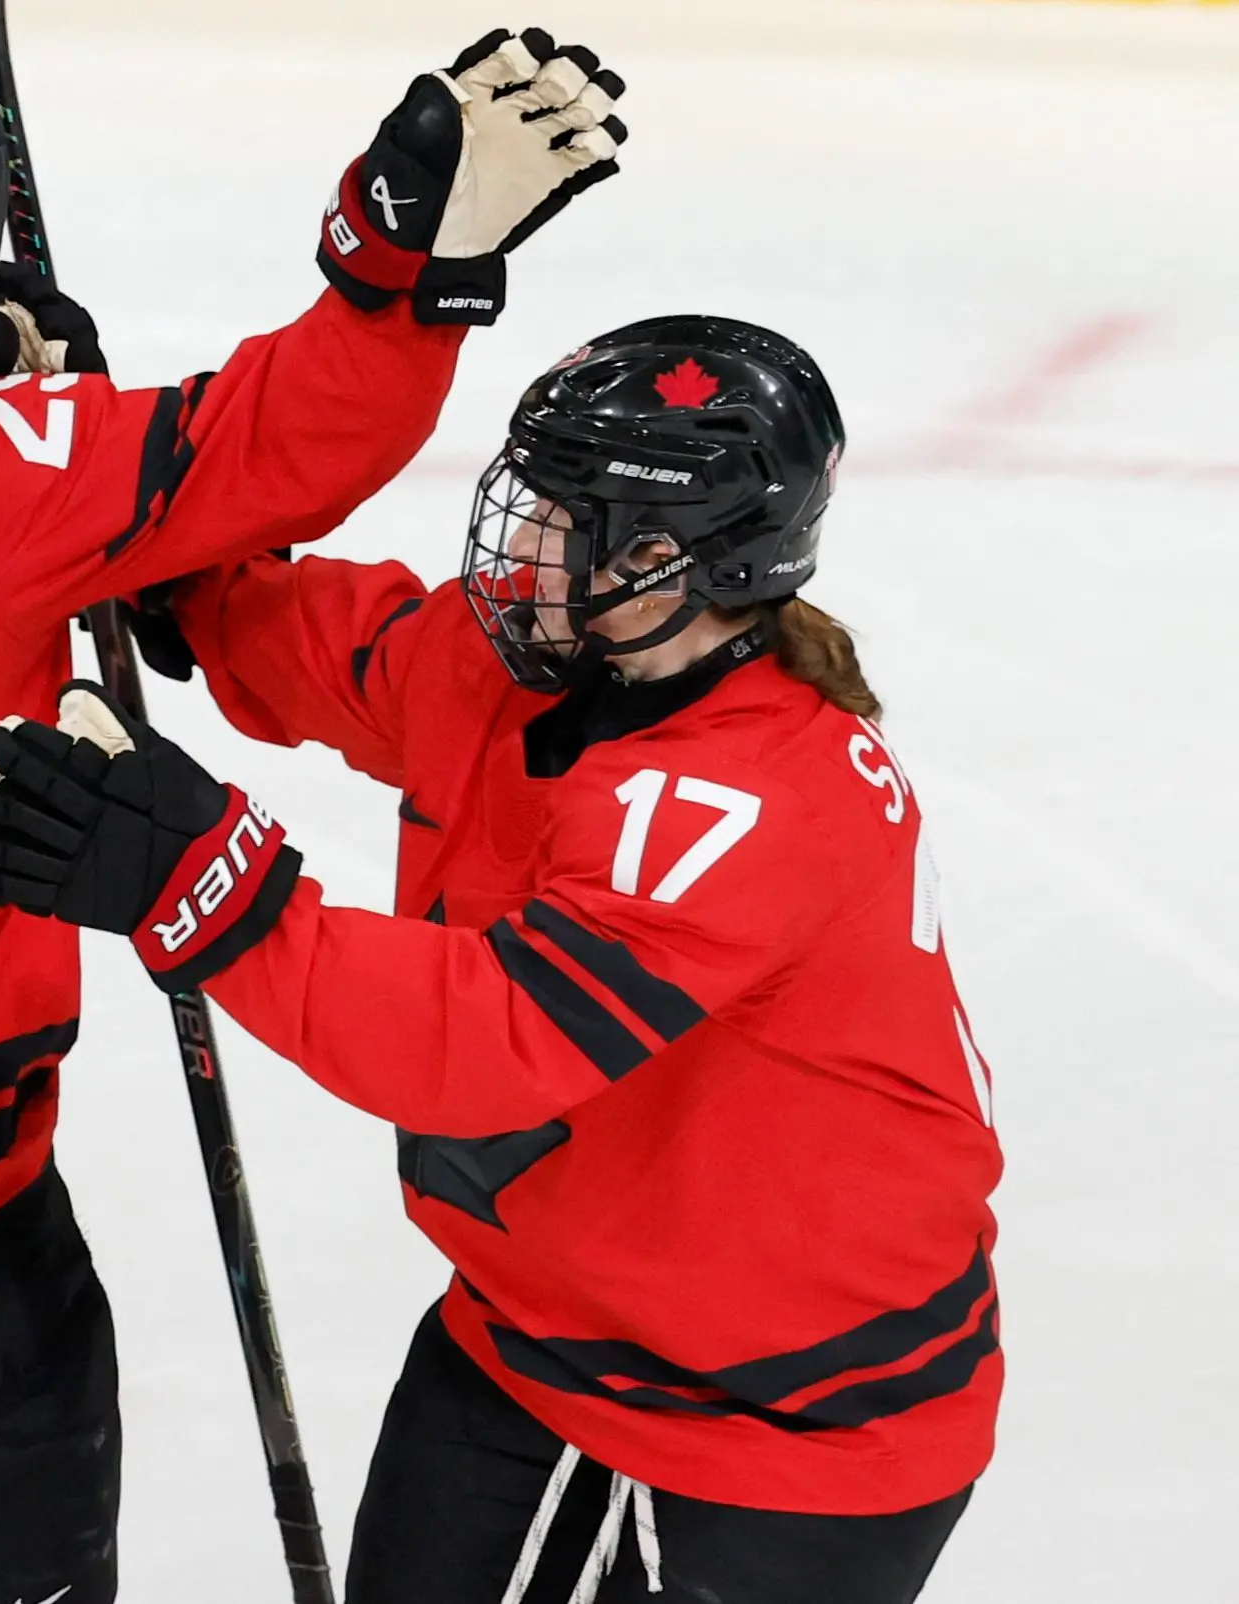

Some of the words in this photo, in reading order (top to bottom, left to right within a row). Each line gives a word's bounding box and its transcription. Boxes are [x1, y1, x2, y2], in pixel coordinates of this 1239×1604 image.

[607, 460, 694, 486] BAUER
[633, 554, 694, 593] BAUER
[152, 794, 273, 953] AUER
[611, 768, 762, 904] 17
